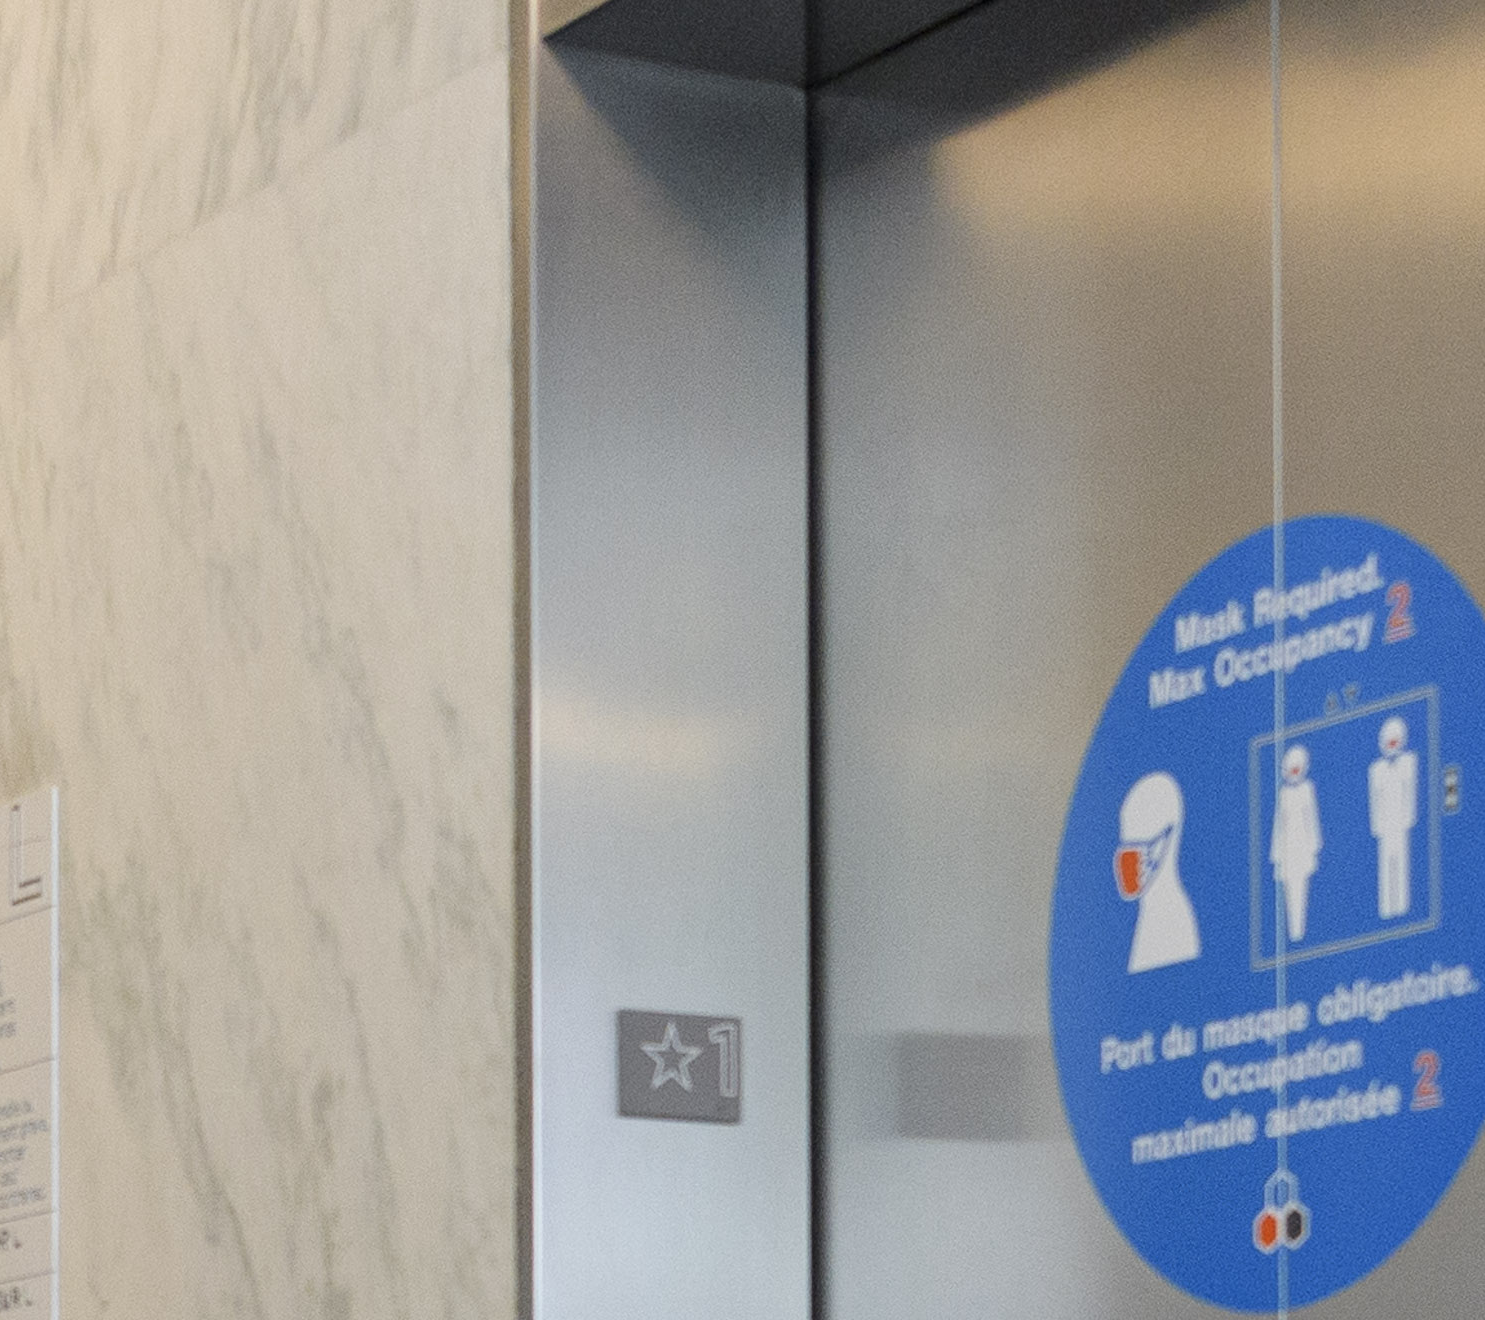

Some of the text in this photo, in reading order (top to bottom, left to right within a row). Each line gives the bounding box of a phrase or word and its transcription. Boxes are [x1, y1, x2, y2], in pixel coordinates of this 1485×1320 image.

[1149, 579, 1416, 709] Max Occupancy 2
[1174, 599, 1246, 654] Mask
[1101, 1030, 1155, 1075] Port
[1161, 1022, 1198, 1061] du
[1202, 1000, 1310, 1052] masque
[1202, 1037, 1364, 1100] Occupation
[1132, 1048, 1444, 1164] maximale autorisée 2
